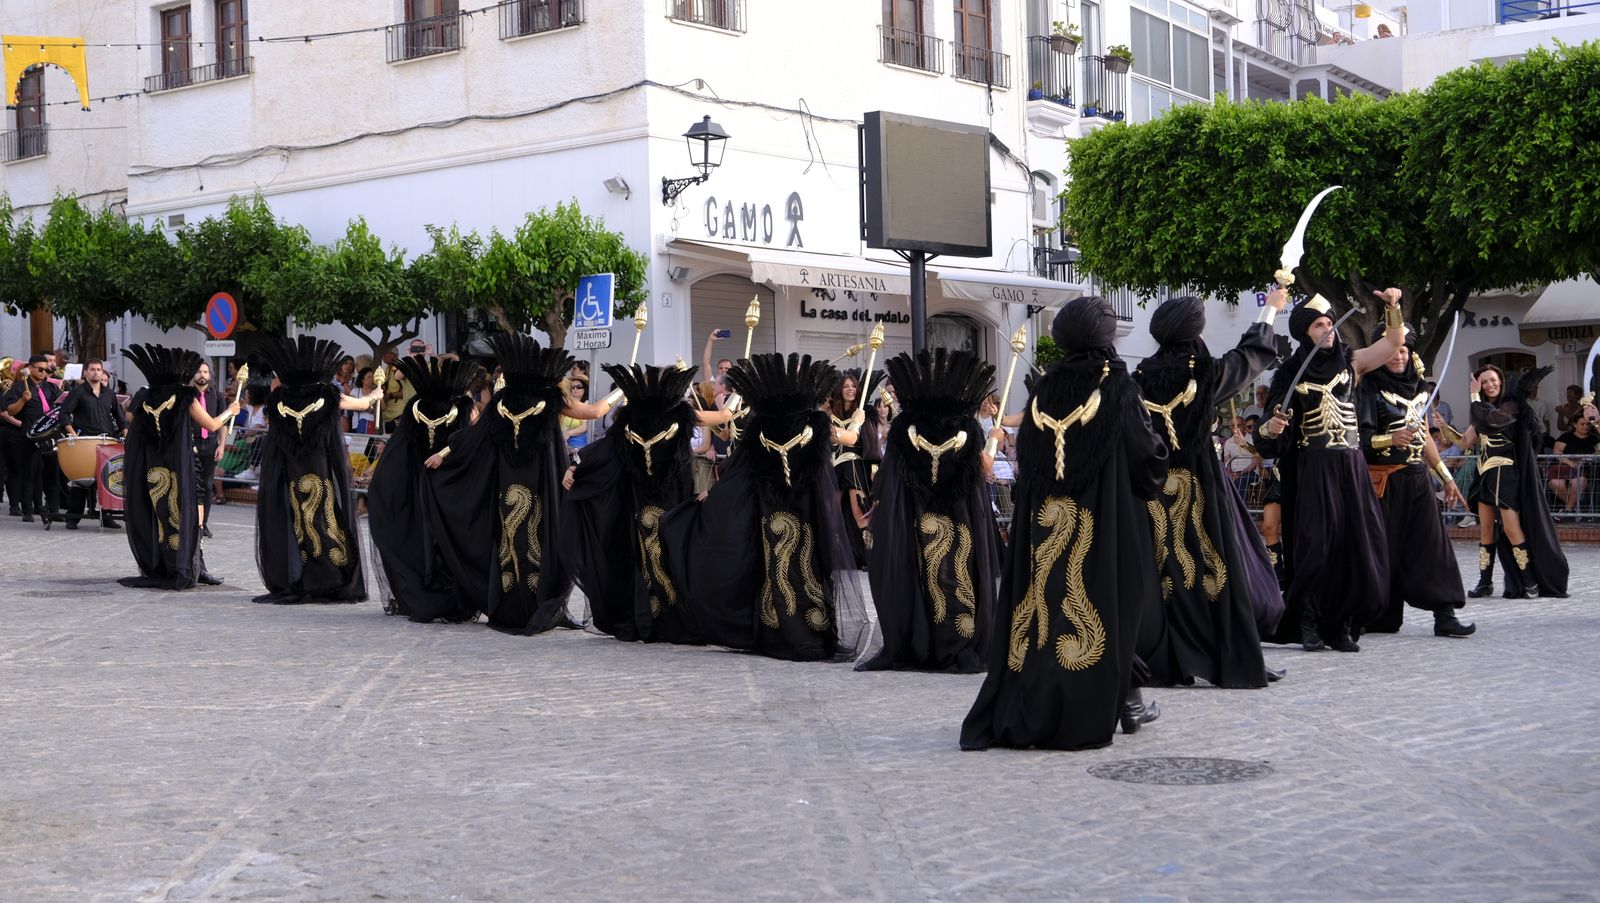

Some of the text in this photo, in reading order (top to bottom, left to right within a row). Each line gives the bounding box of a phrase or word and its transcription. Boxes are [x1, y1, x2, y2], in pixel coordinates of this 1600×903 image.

[705, 195, 773, 244] GAMO
[819, 273, 887, 292] ARTESANIA
[992, 287, 1025, 302] GAMO
[801, 300, 817, 319] La
[821, 308, 848, 321] casa
[1548, 326, 1594, 339] CERVEZA
[577, 340, 607, 349] 2 Horas
